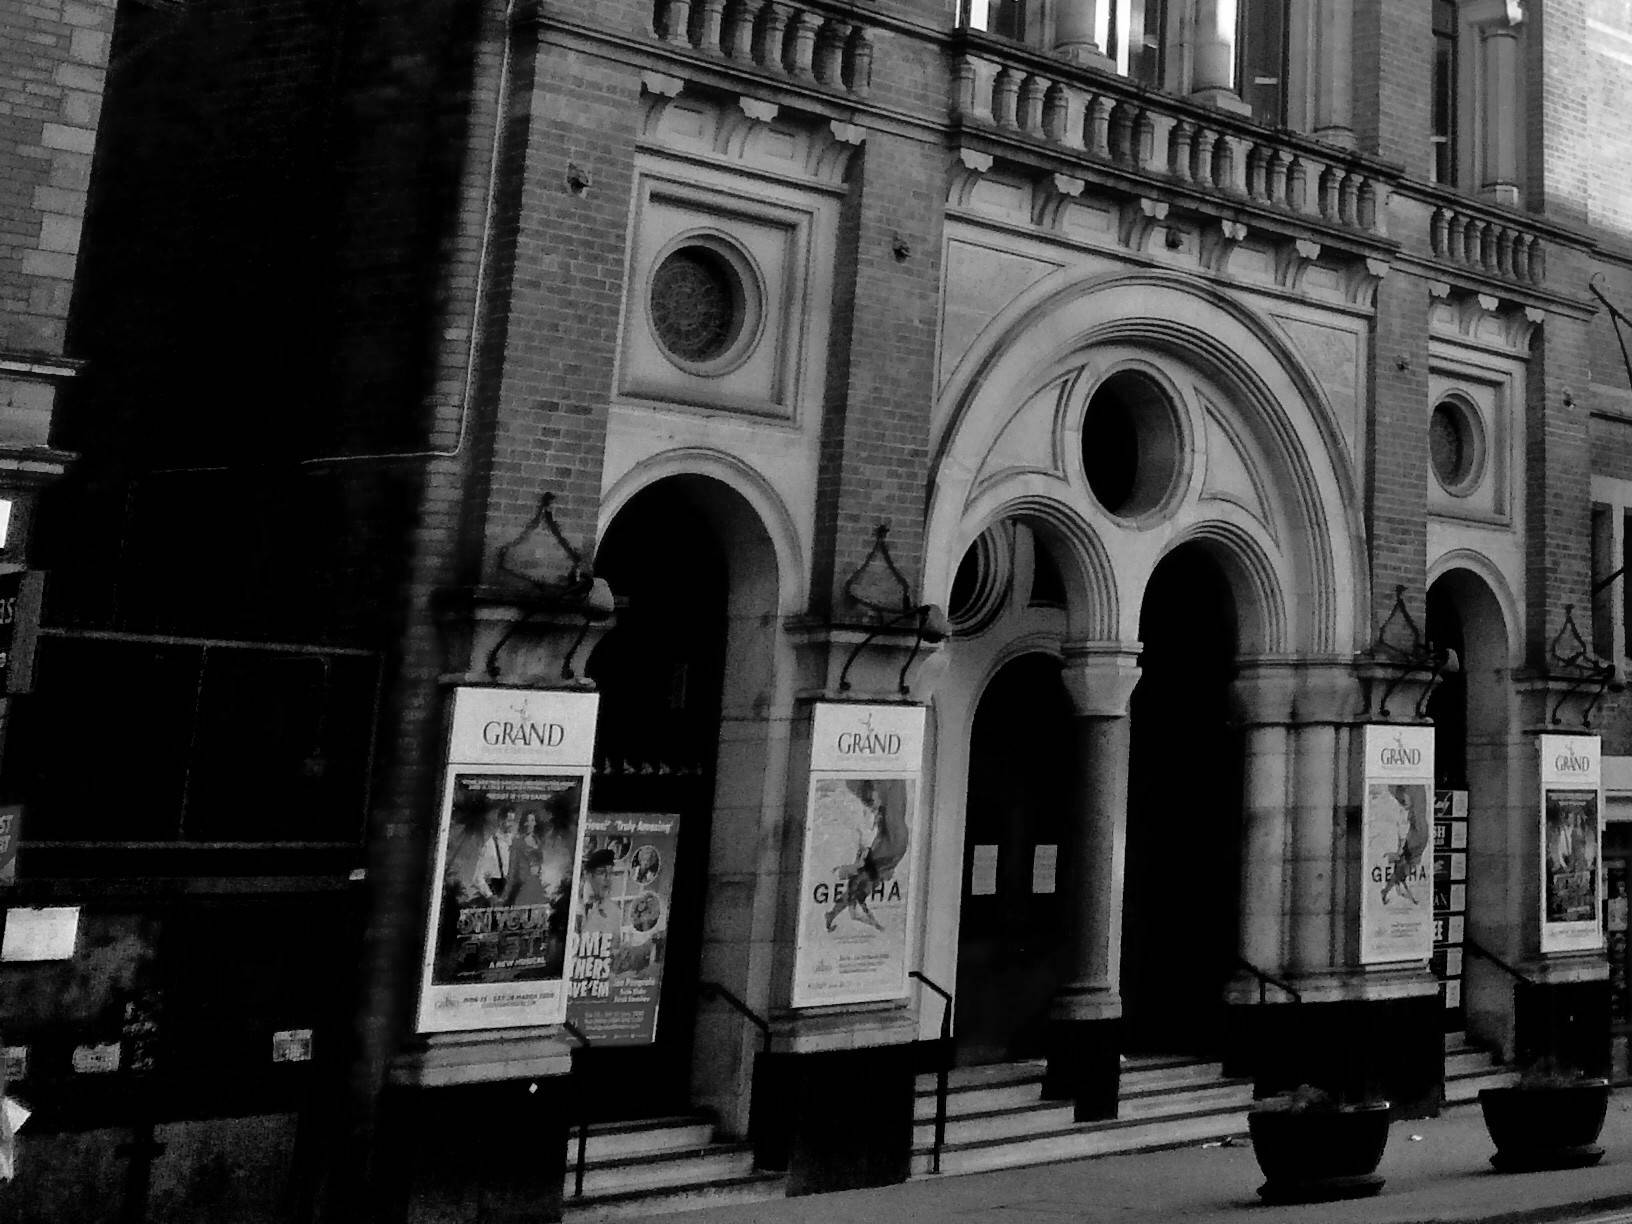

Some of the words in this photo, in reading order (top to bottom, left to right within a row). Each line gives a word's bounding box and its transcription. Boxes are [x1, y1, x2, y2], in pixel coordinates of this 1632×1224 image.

[483, 721, 564, 747] GRAND
[838, 732, 901, 755] GRAND
[1380, 747, 1421, 766] GRAND
[1555, 755, 1590, 772] GRAND
